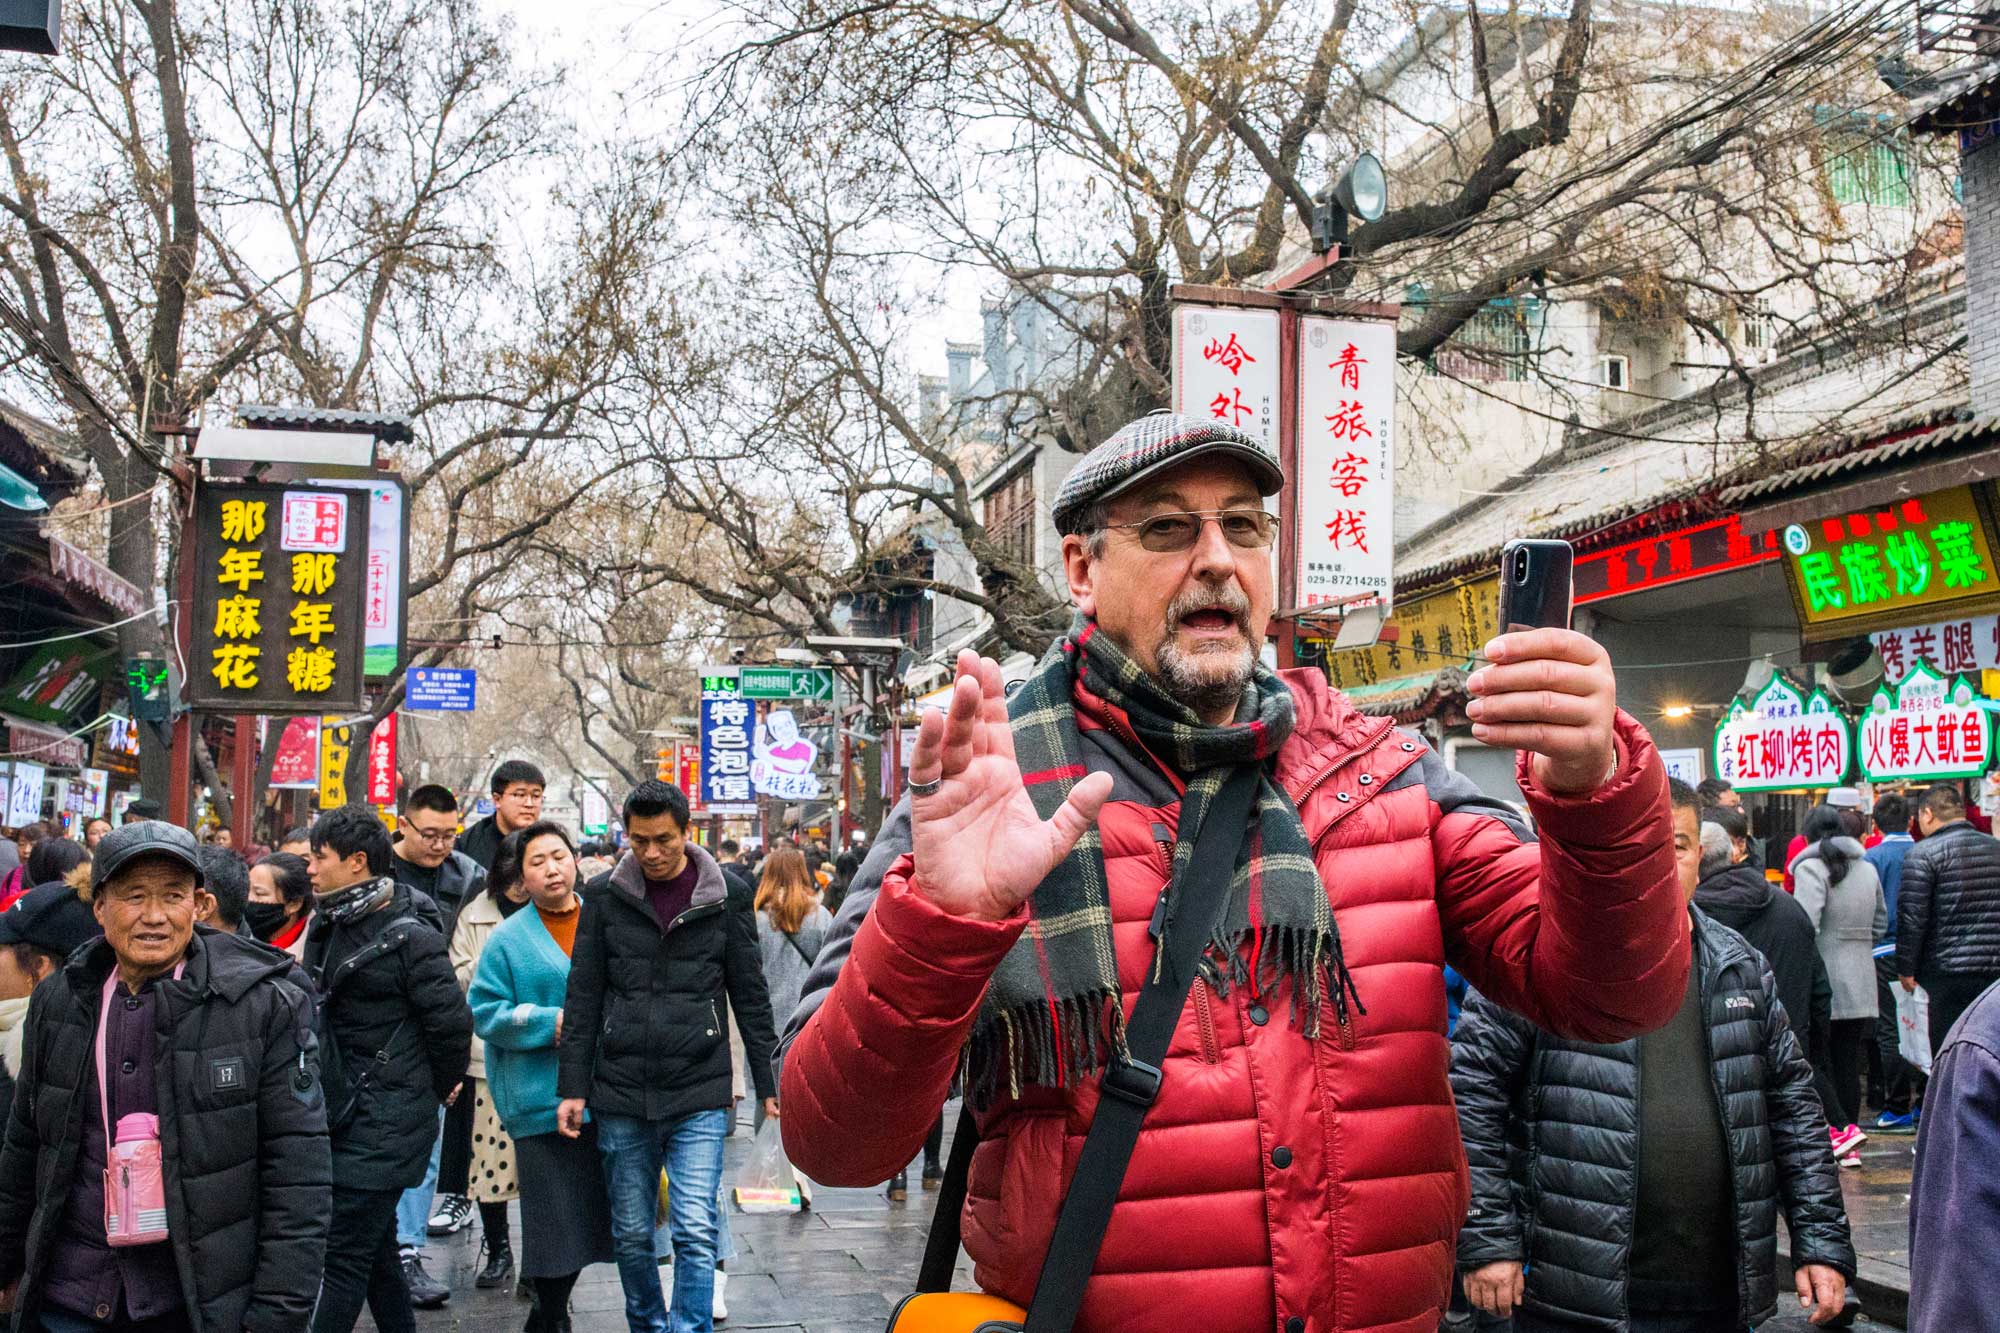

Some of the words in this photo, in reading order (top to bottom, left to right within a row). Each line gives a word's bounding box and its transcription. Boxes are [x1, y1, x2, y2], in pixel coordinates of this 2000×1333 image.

[1204, 333, 1256, 427] 岭外
[1325, 343, 1372, 553] 青旅客栈
[212, 499, 267, 690] 那年麻花
[1307, 575, 1387, 587] 029-87214285
[1801, 521, 1986, 612] 民族炒菜
[287, 552, 336, 692] 那年糖
[1877, 621, 1977, 680] 烤羊腿
[1900, 695, 1942, 712] 陕西名小吃
[375, 741, 390, 797] 高家大院
[708, 701, 749, 800] 特色泡馍
[1722, 735, 1734, 777] 正宗
[1737, 722, 1841, 779] 红柳烤肉
[1867, 711, 1984, 769] 火爆大鱿鱼
